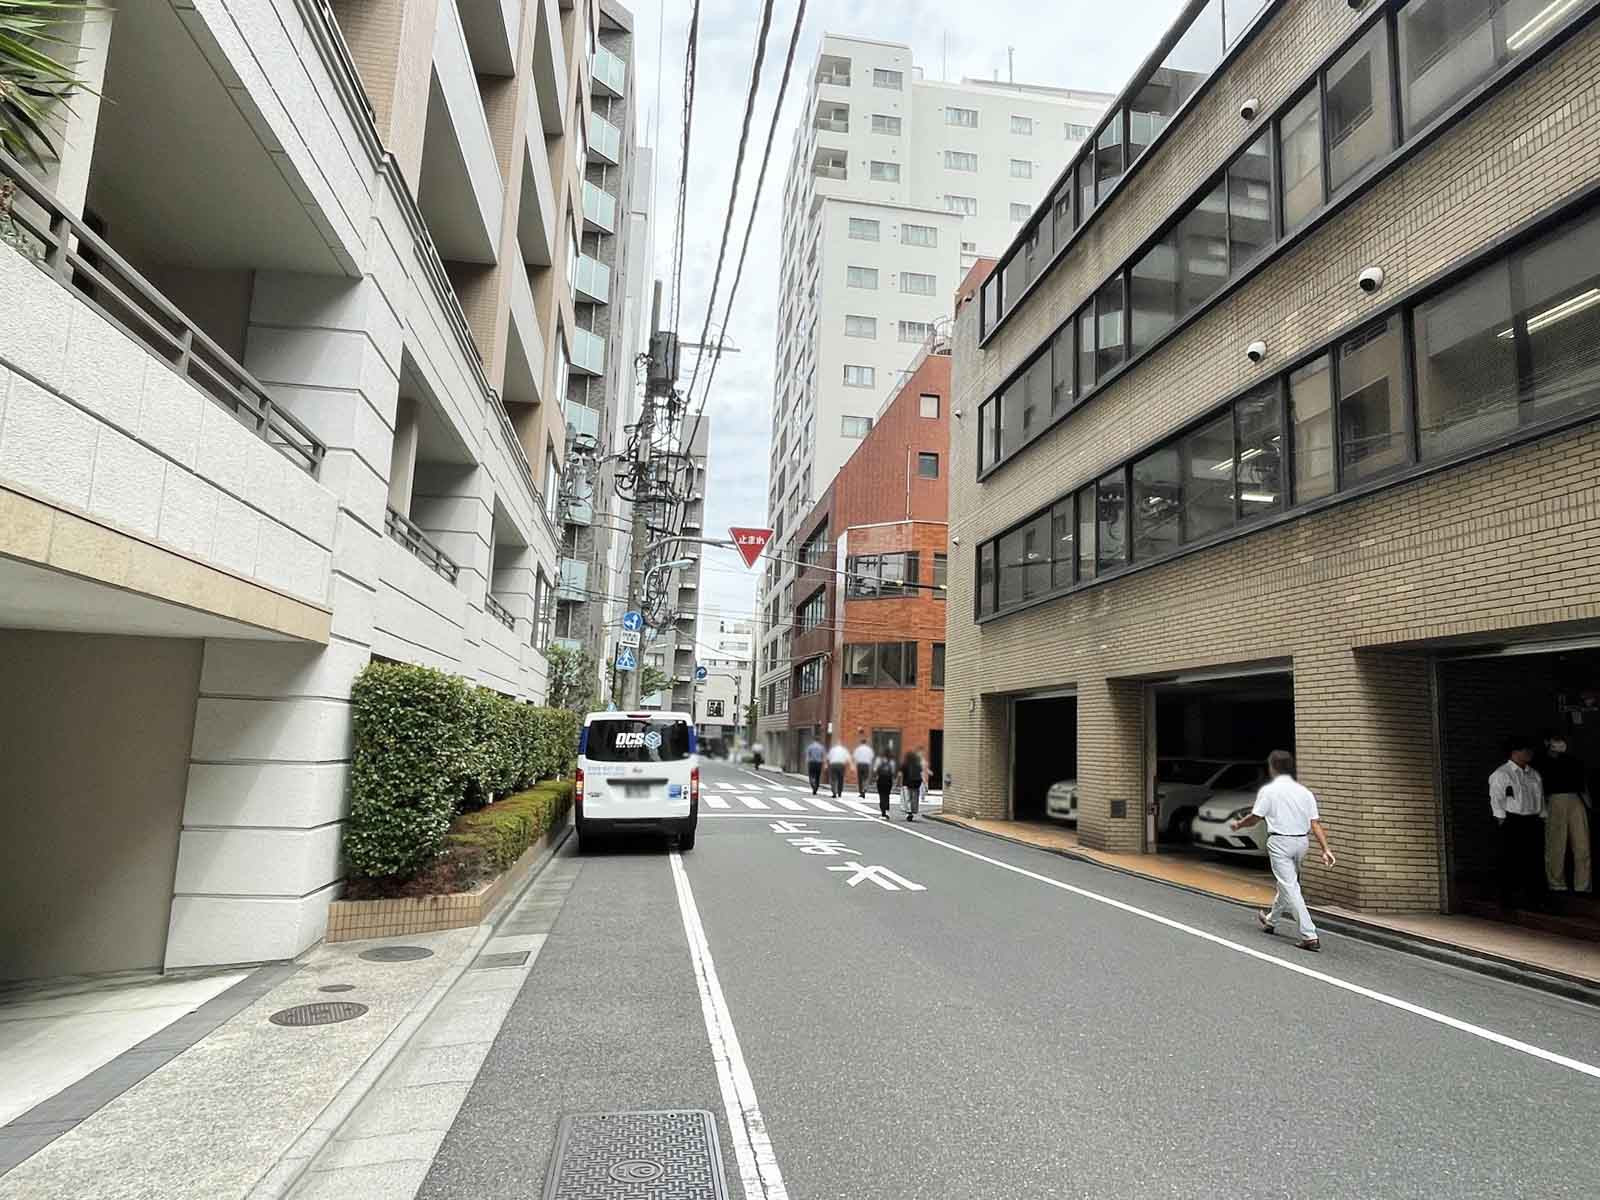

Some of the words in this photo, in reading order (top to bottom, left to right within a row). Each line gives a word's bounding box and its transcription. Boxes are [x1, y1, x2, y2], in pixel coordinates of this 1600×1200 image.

[738, 535, 765, 545] 止まれ
[768, 820, 928, 891] 止まれ
